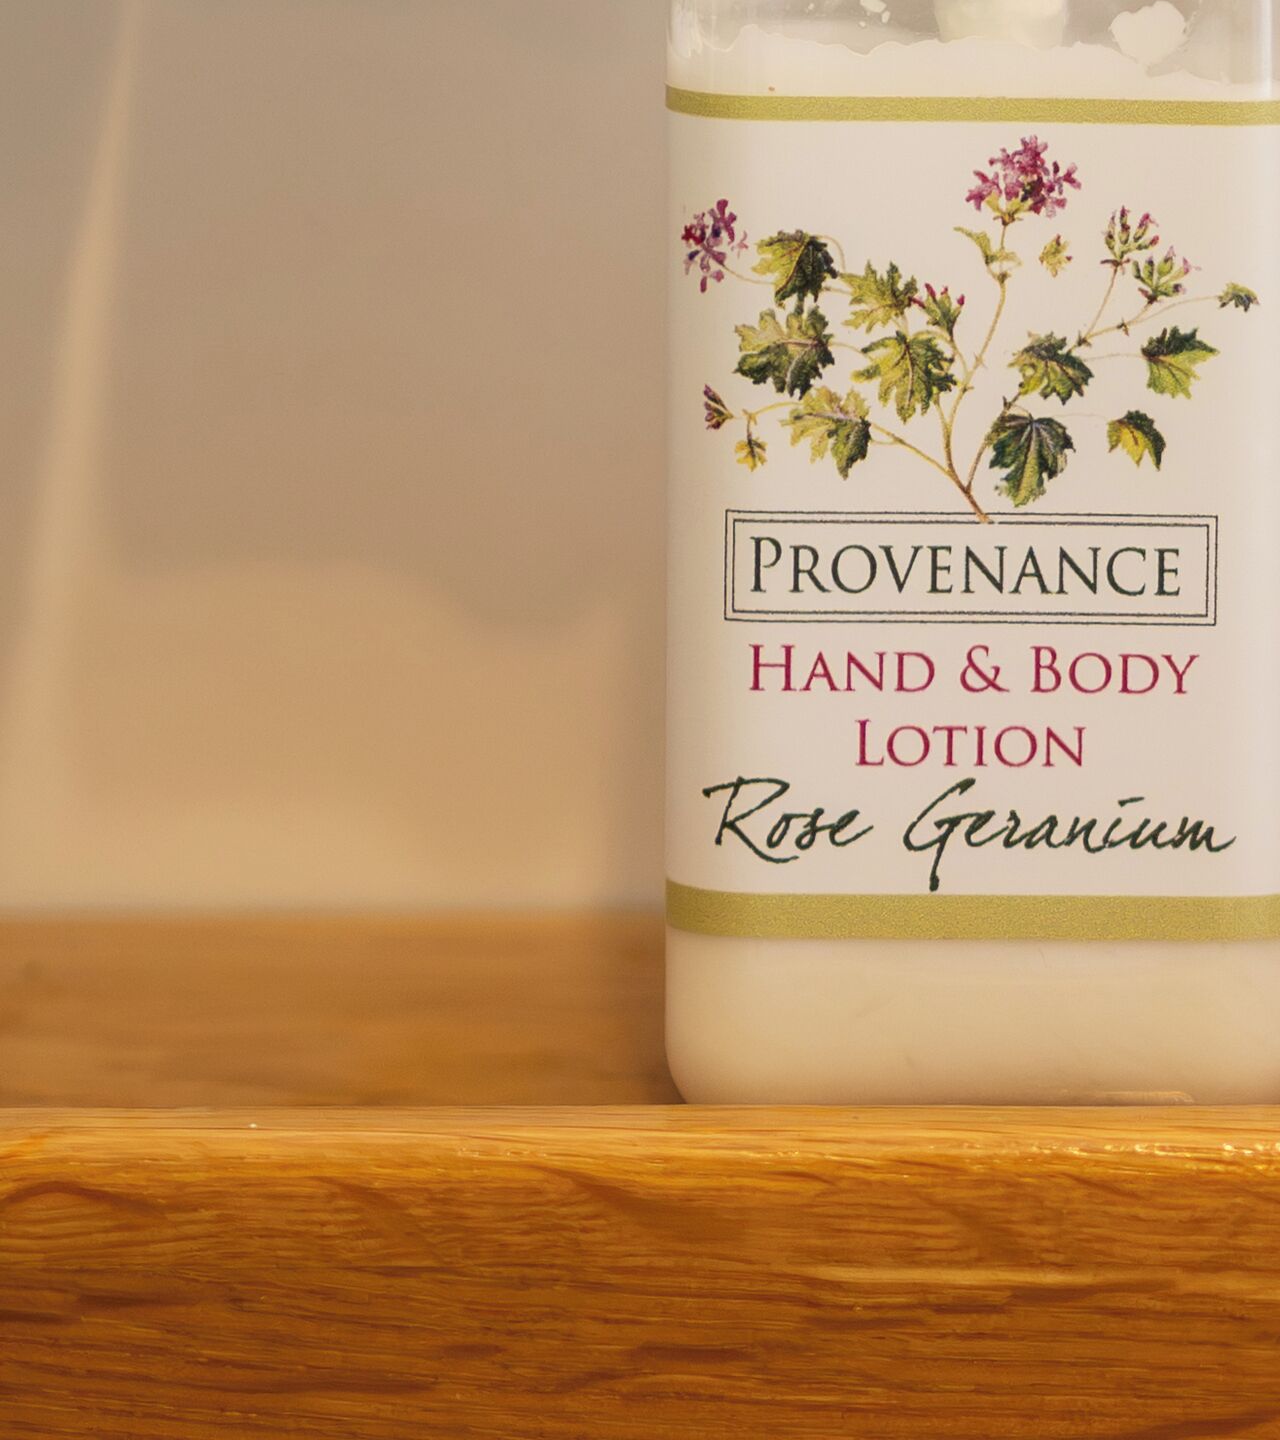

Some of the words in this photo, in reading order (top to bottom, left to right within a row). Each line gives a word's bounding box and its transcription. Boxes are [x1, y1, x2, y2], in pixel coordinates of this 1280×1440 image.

[749, 535, 1182, 597] PROVENANCE
[748, 644, 936, 693] HAND
[959, 644, 1010, 693] &
[1030, 646, 1200, 695] BODY
[854, 719, 1087, 768] LOTION
[701, 775, 874, 864] Rose
[902, 777, 1237, 892] Geranium
